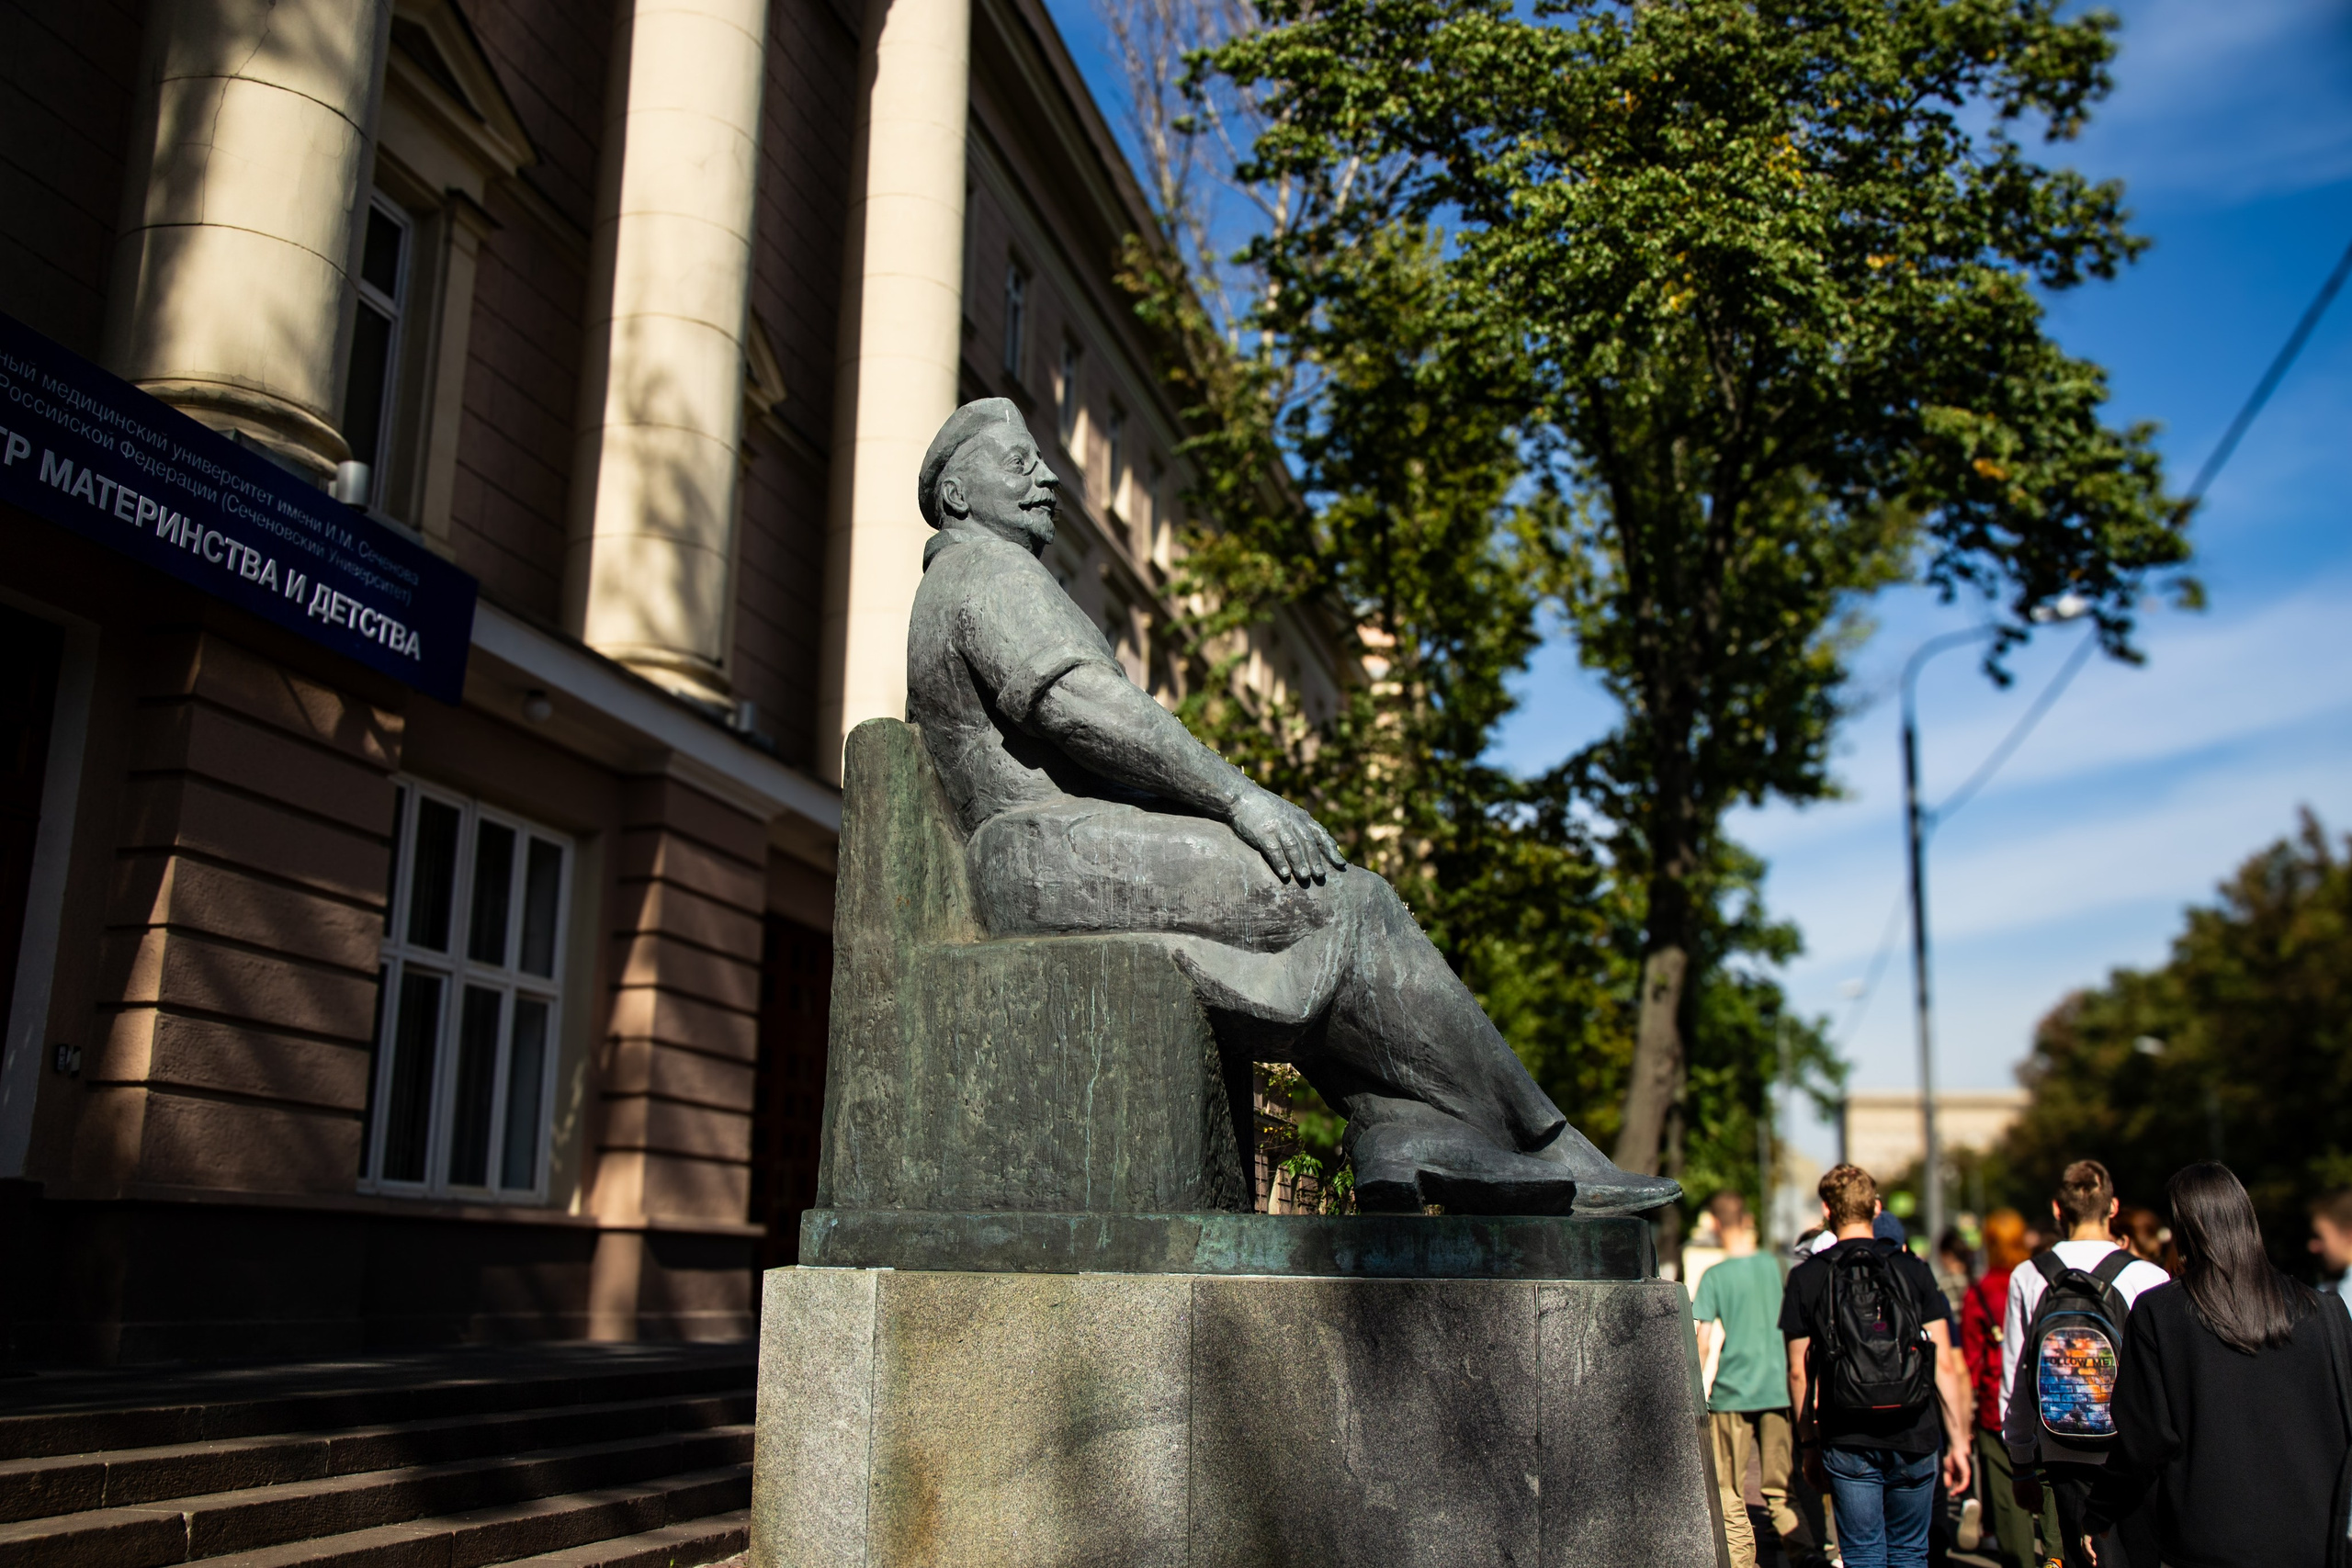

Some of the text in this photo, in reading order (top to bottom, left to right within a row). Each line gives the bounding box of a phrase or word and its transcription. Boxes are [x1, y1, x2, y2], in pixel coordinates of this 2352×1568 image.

[39, 448, 278, 592] МАТЕРИНСТВА
[285, 569, 308, 604] И
[307, 581, 422, 661] ДЕТСТВА
[41, 374, 168, 451] медицинский
[172, 443, 275, 506] университет
[277, 499, 322, 533] имени
[324, 521, 354, 551] И.М.
[358, 540, 420, 586] Сеченова
[120, 440, 218, 503] Федерации
[221, 491, 325, 558] (Сеченовский
[328, 547, 413, 607] Университет)
[2044, 1358, 2087, 1367] FOLLOW
